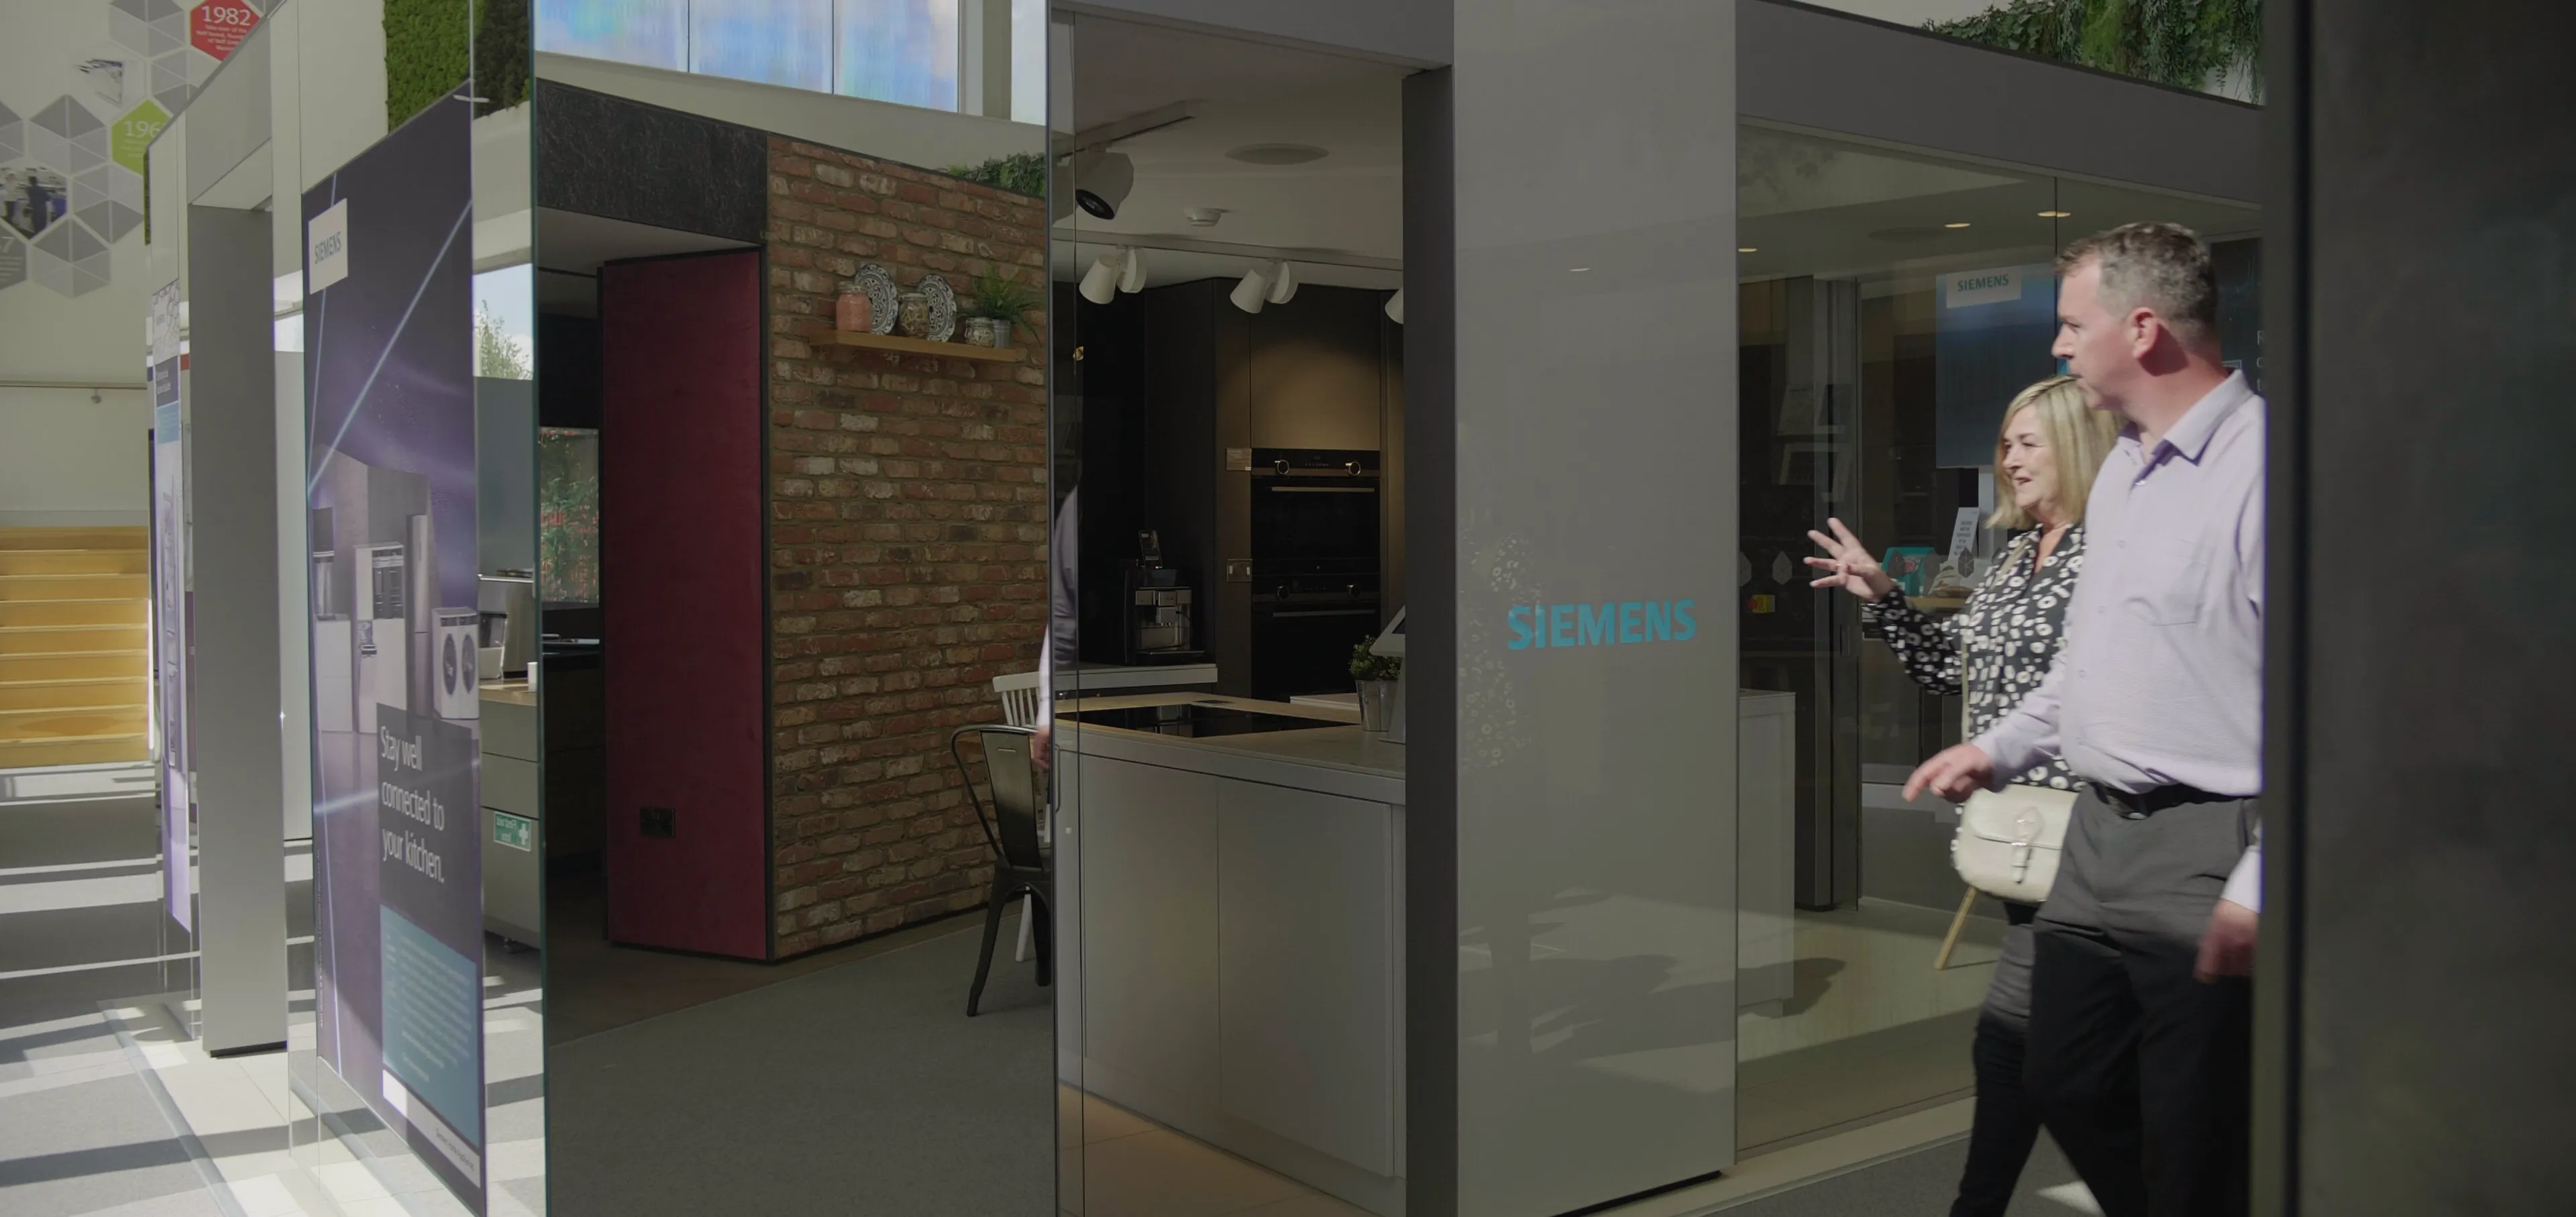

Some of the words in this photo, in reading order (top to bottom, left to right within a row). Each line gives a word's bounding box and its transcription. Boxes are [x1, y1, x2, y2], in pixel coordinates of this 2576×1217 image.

[202, 5, 250, 25] 1982
[123, 119, 166, 138] 196
[315, 231, 341, 264] SIEMENS
[1957, 274, 2010, 292] SIEMENS
[1506, 598, 1697, 650] SIEMENS
[380, 725, 401, 772] Stay
[402, 735, 422, 771] well
[382, 781, 431, 825] connected
[433, 797, 445, 831] to
[382, 829, 403, 861] your
[405, 829, 445, 884] kitchen.
